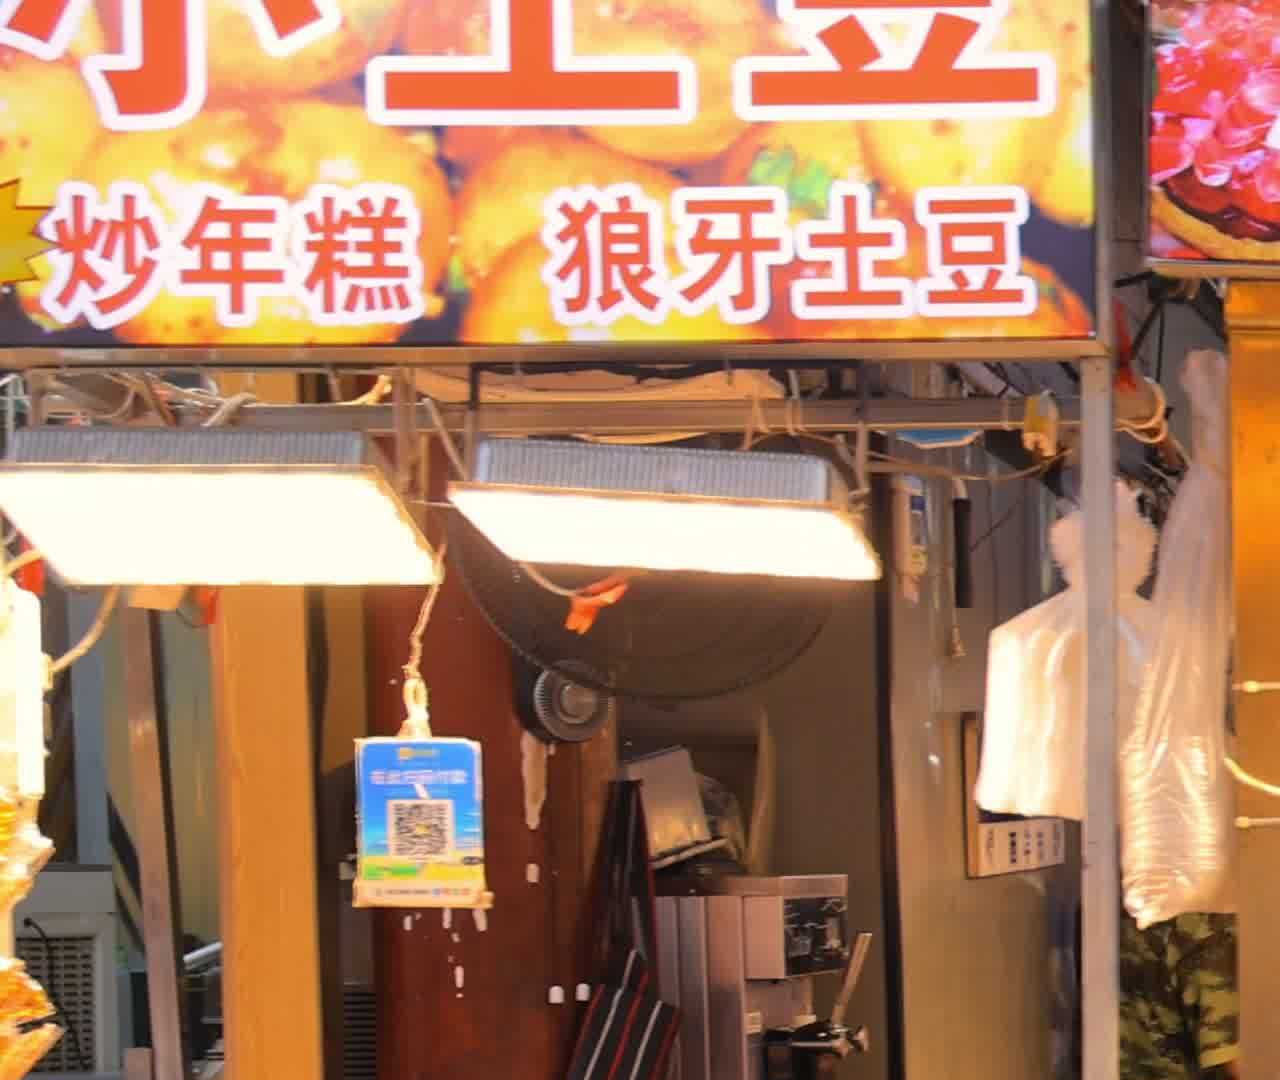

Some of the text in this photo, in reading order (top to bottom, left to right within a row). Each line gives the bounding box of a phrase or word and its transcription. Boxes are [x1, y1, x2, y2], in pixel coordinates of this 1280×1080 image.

[53, 195, 414, 315] 炒年糕
[553, 197, 1027, 314] 狼牙土豆
